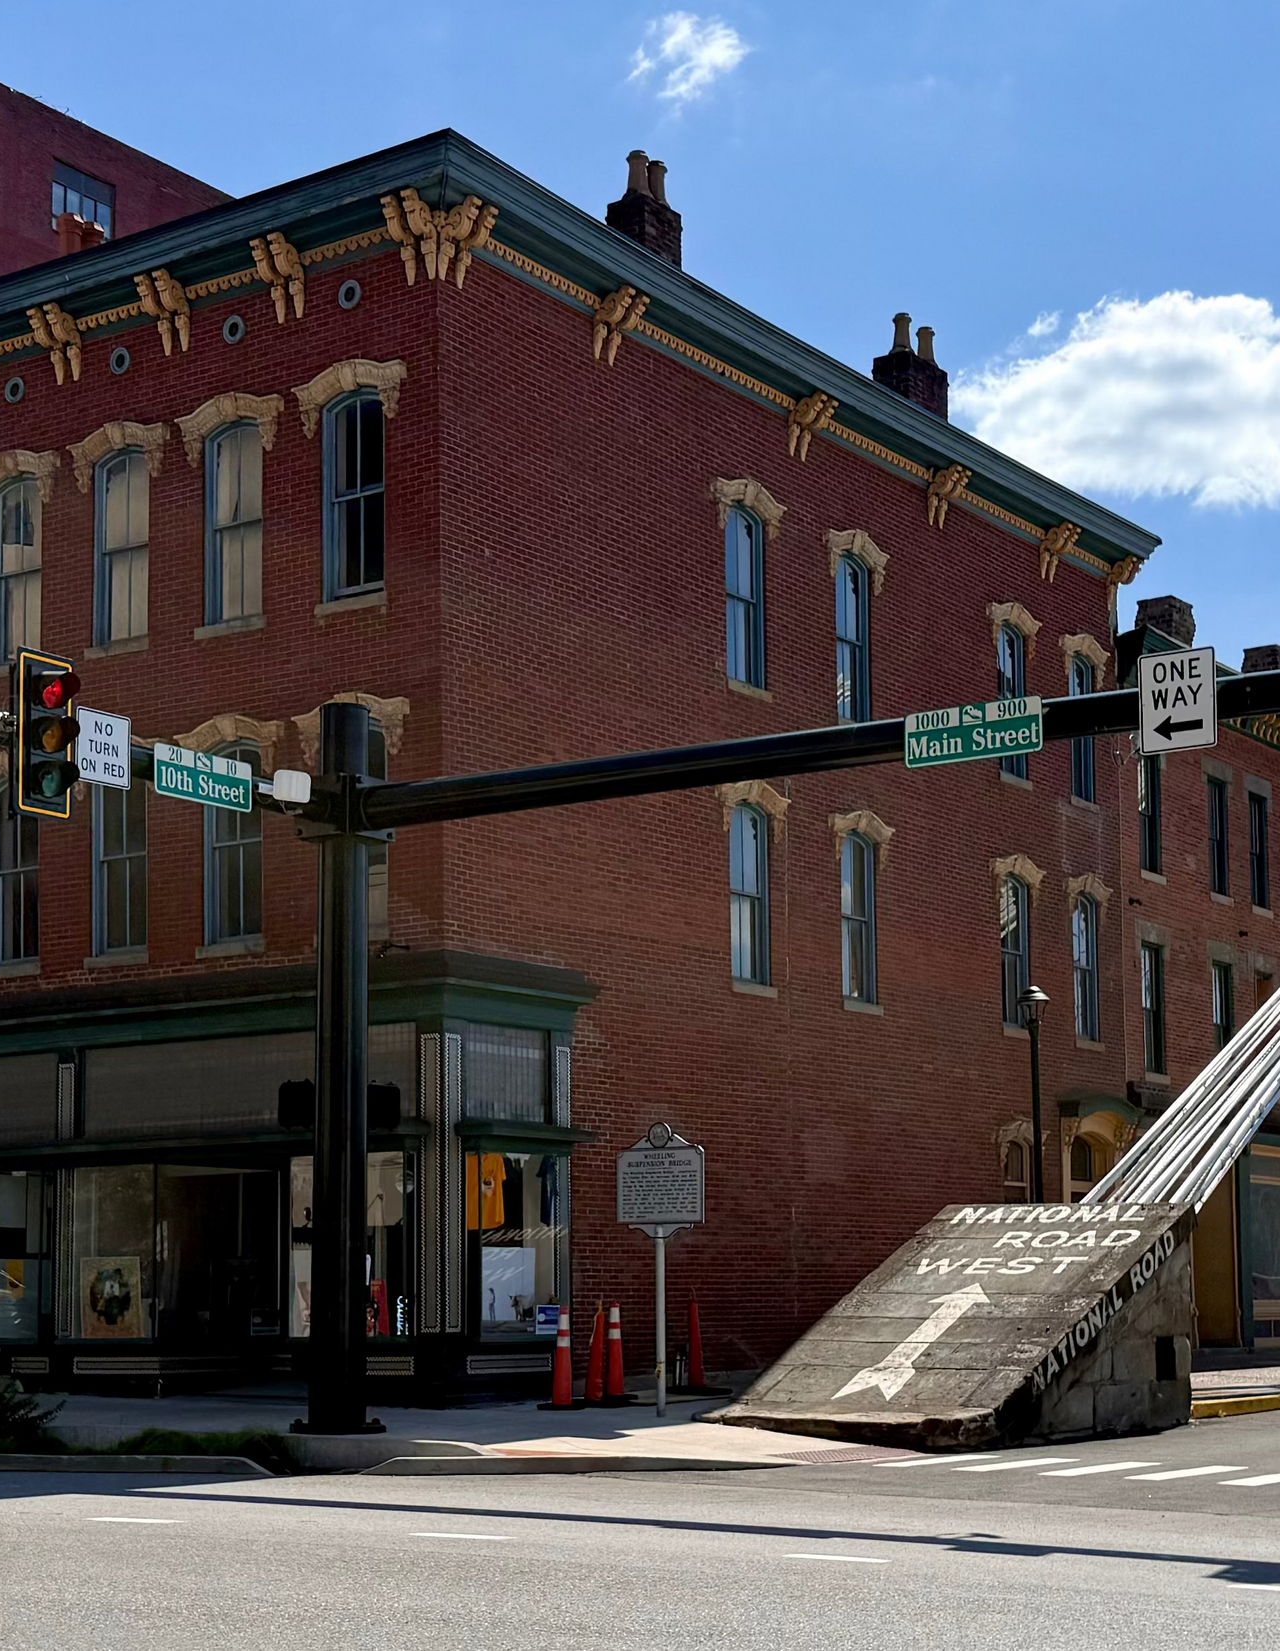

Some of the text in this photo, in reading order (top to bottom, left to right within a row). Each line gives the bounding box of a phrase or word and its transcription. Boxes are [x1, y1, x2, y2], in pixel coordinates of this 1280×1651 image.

[1152, 657, 1202, 684] ONE
[1151, 683, 1203, 711] WAY
[914, 699, 1027, 731] 1000 900
[94, 720, 114, 737] NO
[88, 739, 119, 758] TURN
[908, 722, 1039, 760] Main Street
[81, 757, 125, 779] ON RED
[168, 747, 237, 776] 20 10
[160, 766, 246, 805] 10th Street
[668, 1159, 692, 1167] BRIDGE
[949, 1204, 1146, 1224] NATIONAL
[992, 1229, 1142, 1249] ROAD
[916, 1256, 1090, 1275] WEST
[1031, 1229, 1175, 1394] NATIONAL ROAD
